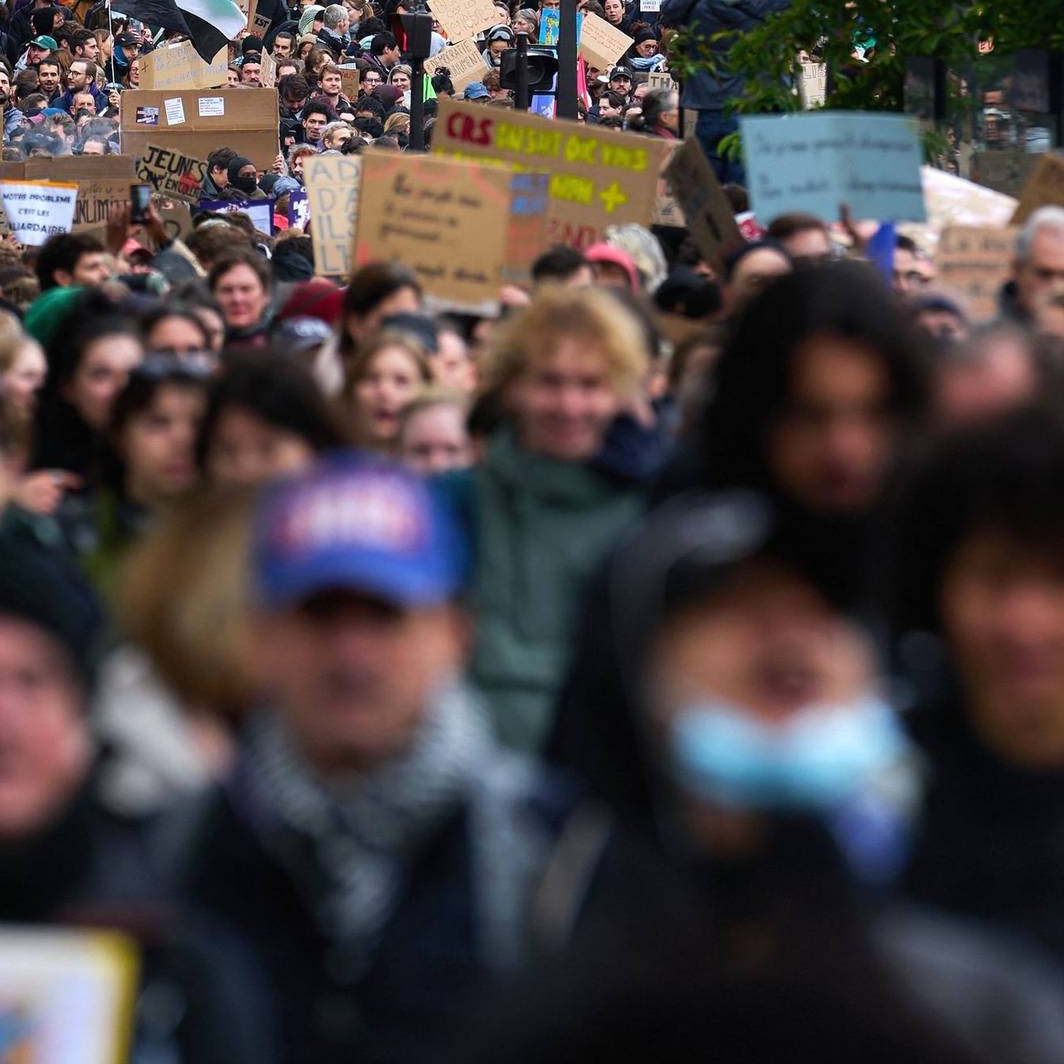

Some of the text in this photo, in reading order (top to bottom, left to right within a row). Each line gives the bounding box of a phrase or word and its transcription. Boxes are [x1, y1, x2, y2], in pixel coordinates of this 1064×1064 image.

[254, 17, 270, 29] EST
[446, 111, 494, 147] CRS
[142, 146, 207, 183] JEUNES
[37, 209, 50, 217] LES
